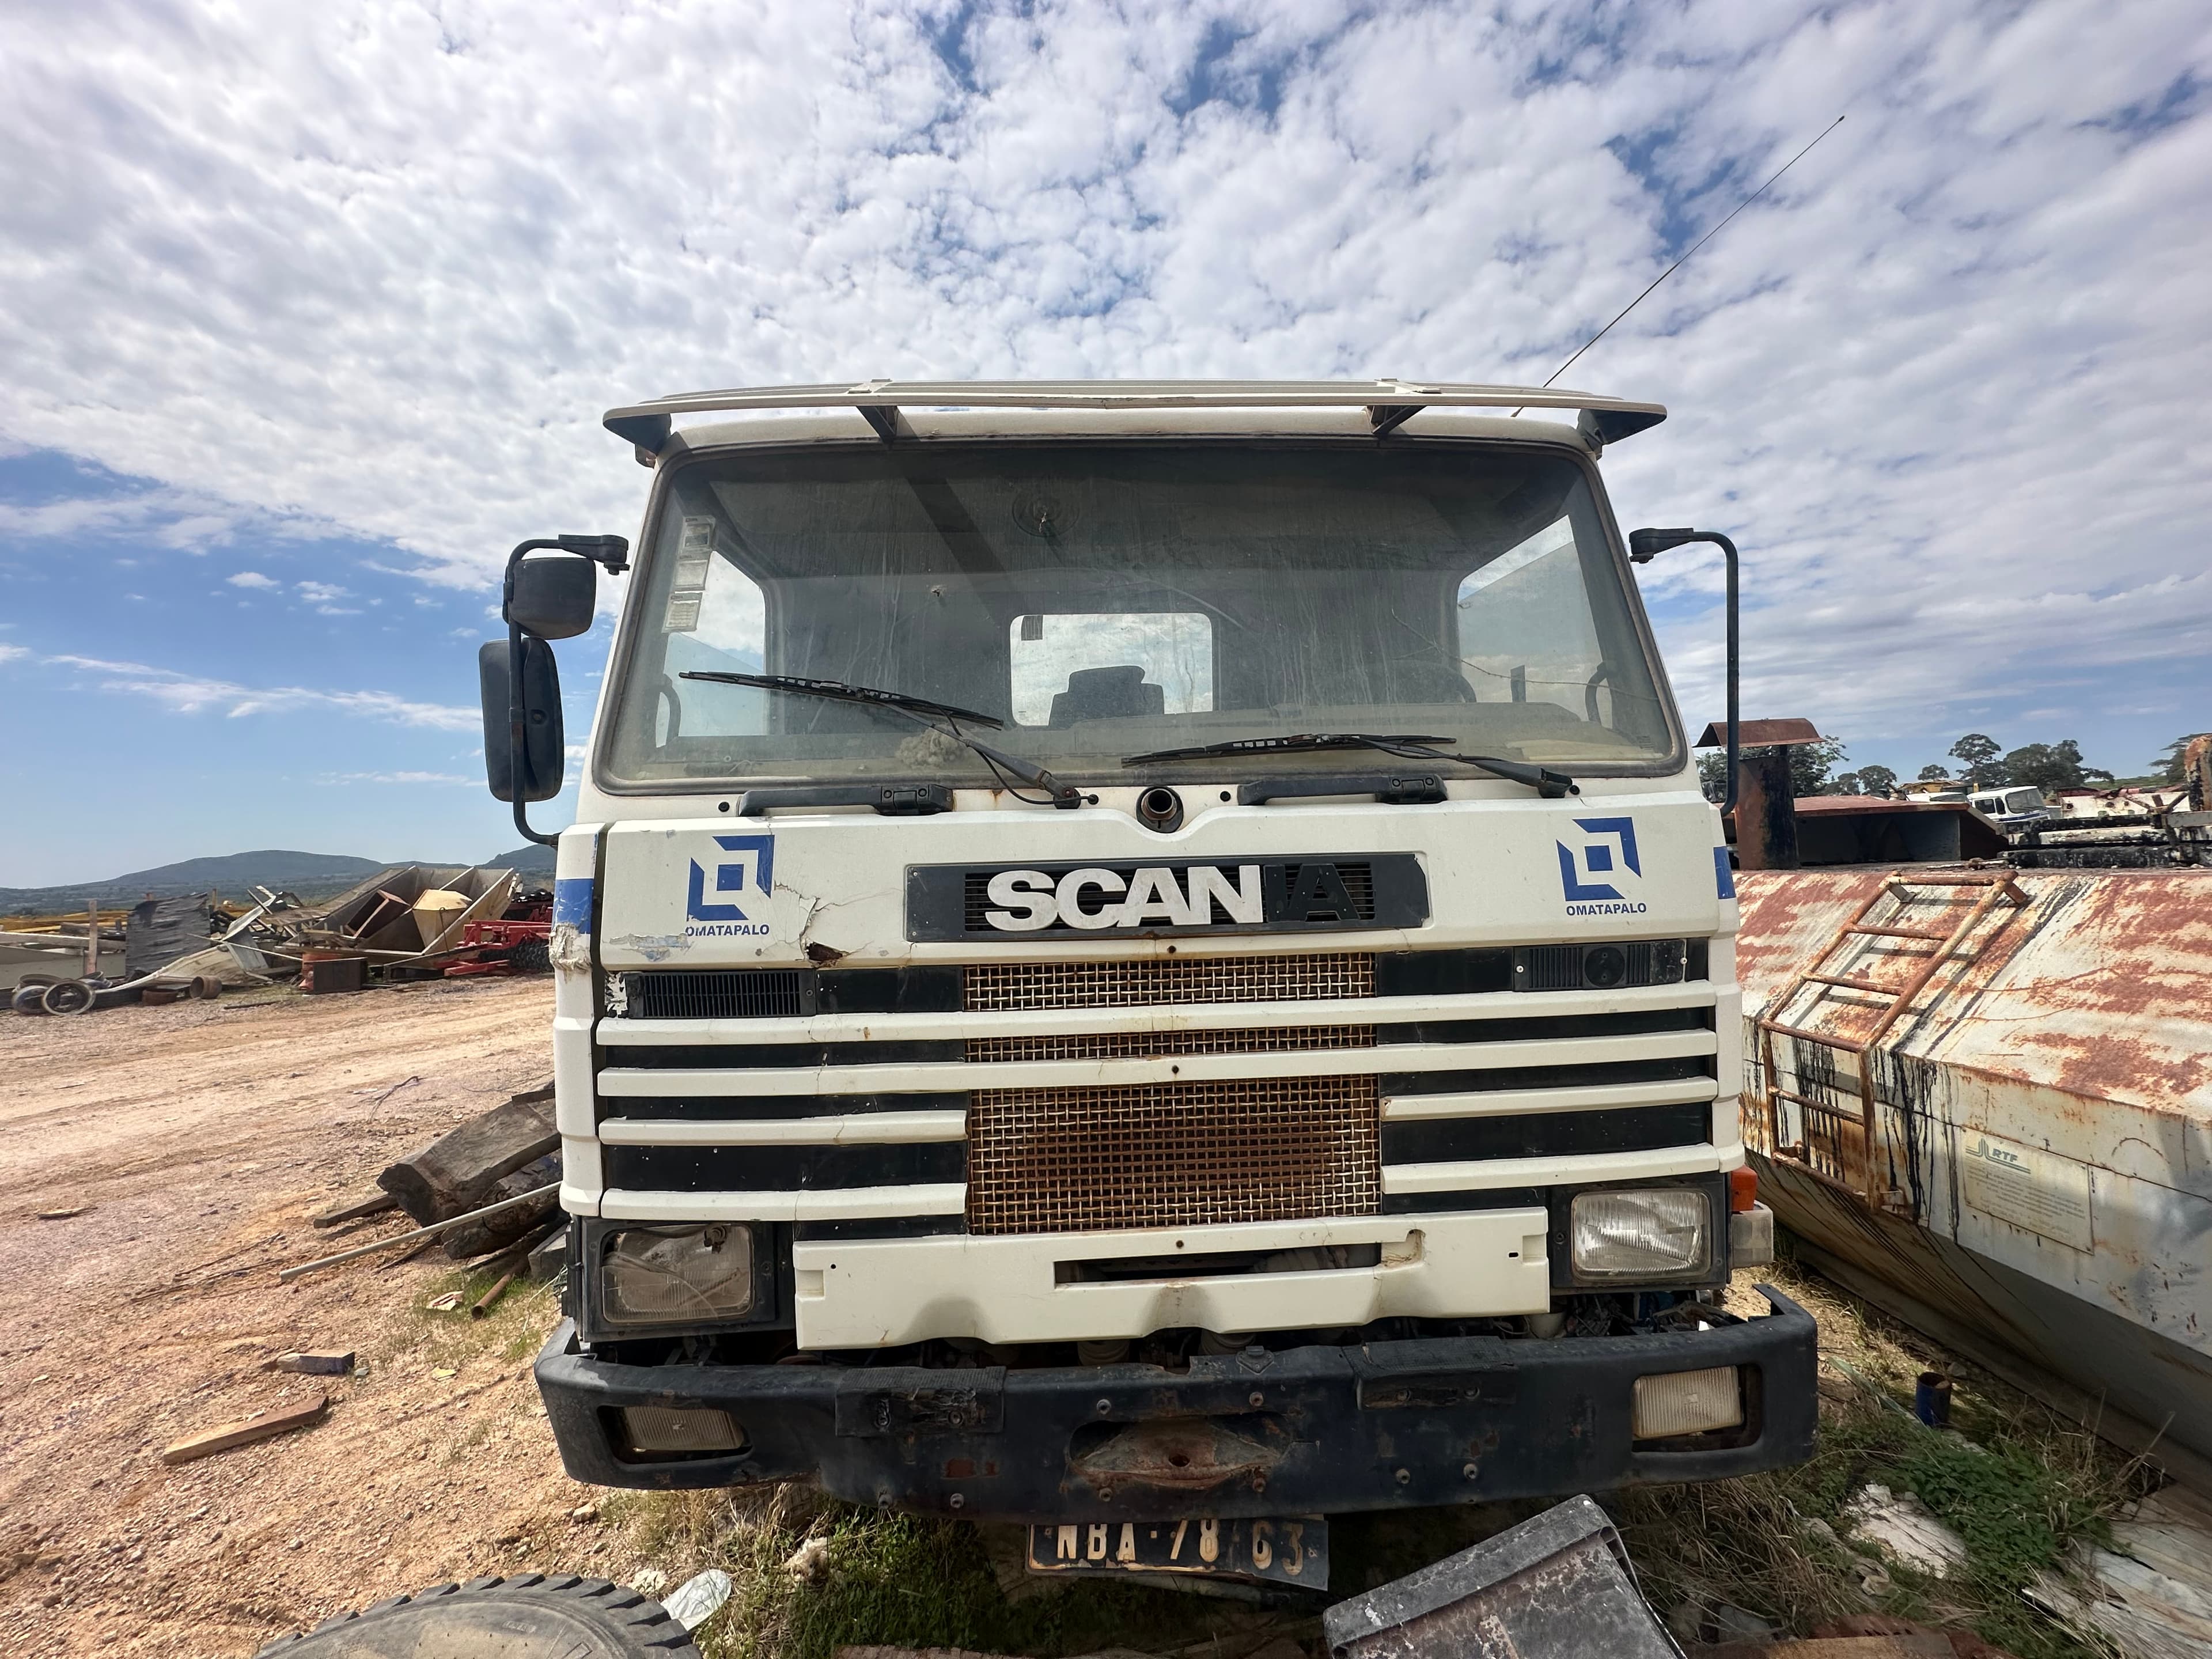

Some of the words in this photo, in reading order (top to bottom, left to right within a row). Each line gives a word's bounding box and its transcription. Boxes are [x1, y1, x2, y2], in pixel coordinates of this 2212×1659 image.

[1566, 903, 1647, 916] OMATAPALO
[685, 924, 770, 937] OMATAPALO
[1992, 1148, 2018, 1162] RTF
